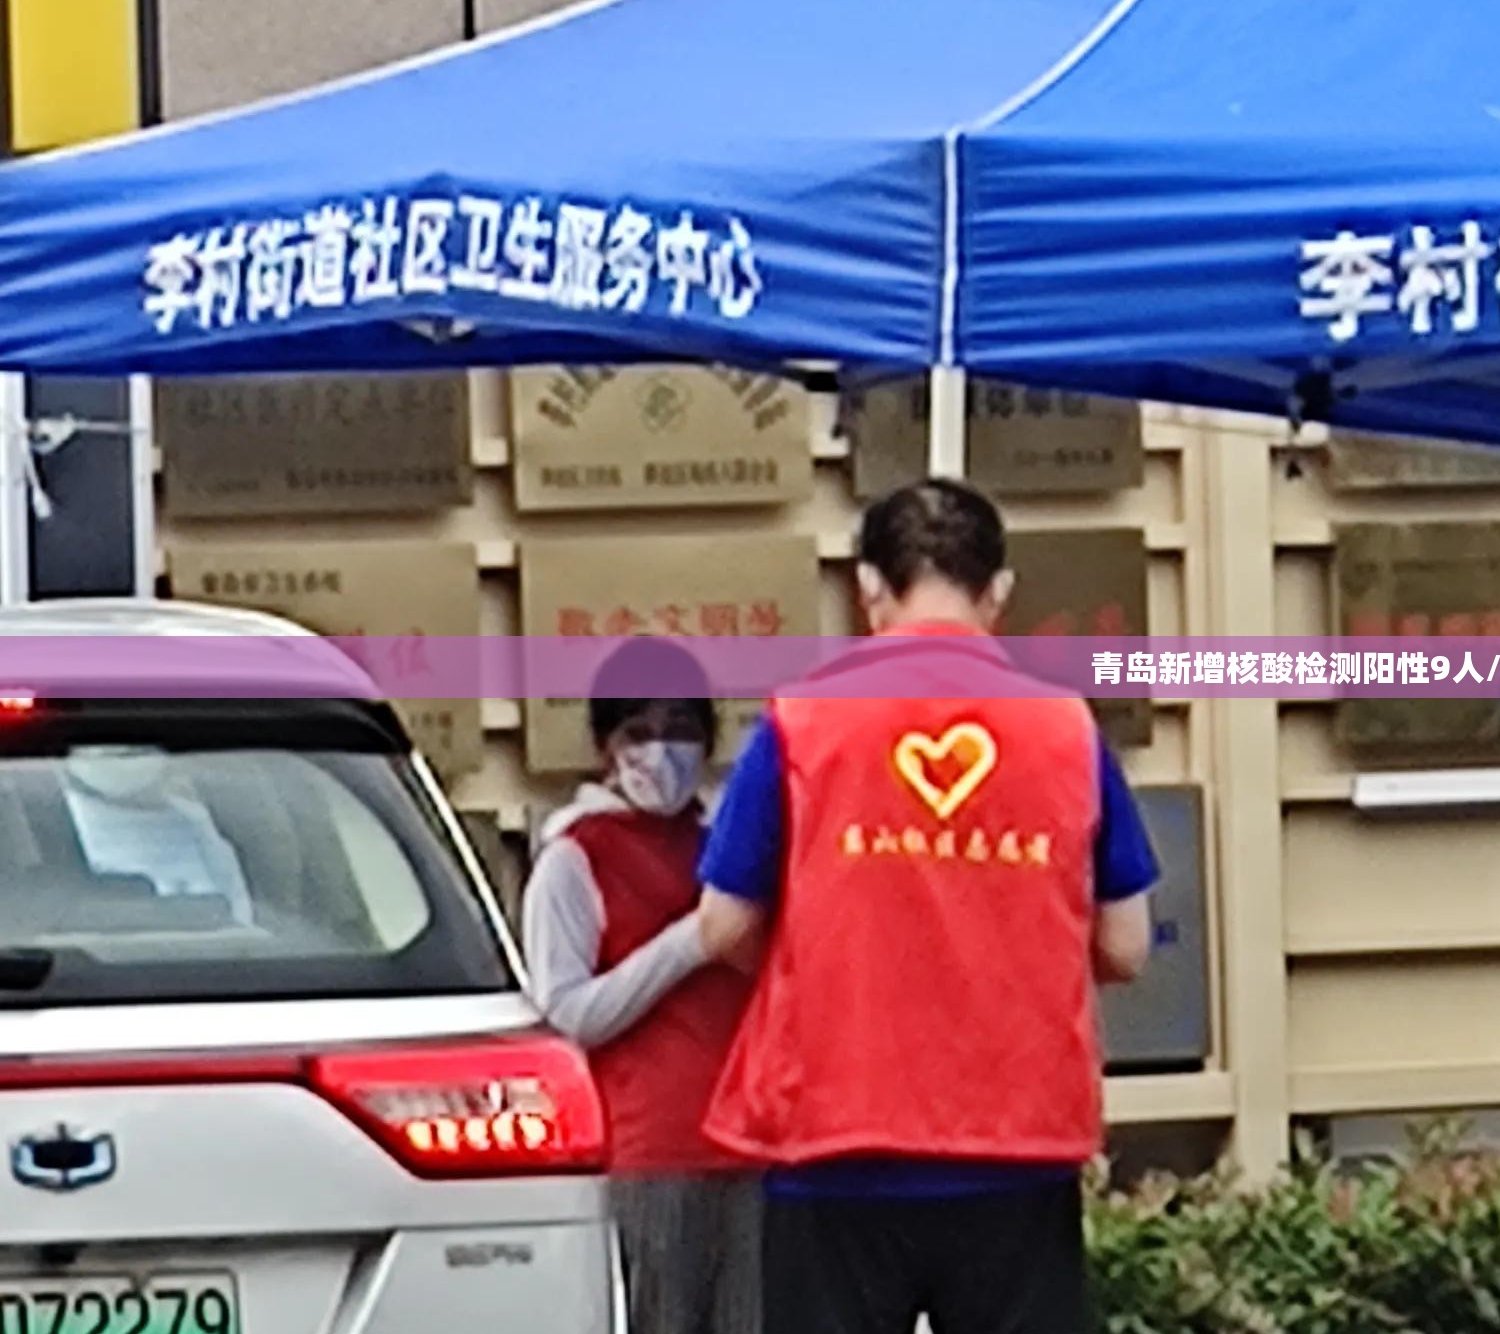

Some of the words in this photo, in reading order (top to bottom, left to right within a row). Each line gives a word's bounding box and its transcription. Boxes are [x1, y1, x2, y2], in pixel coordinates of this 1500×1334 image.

[143, 196, 763, 333] 李村街道社区卫生服务中心
